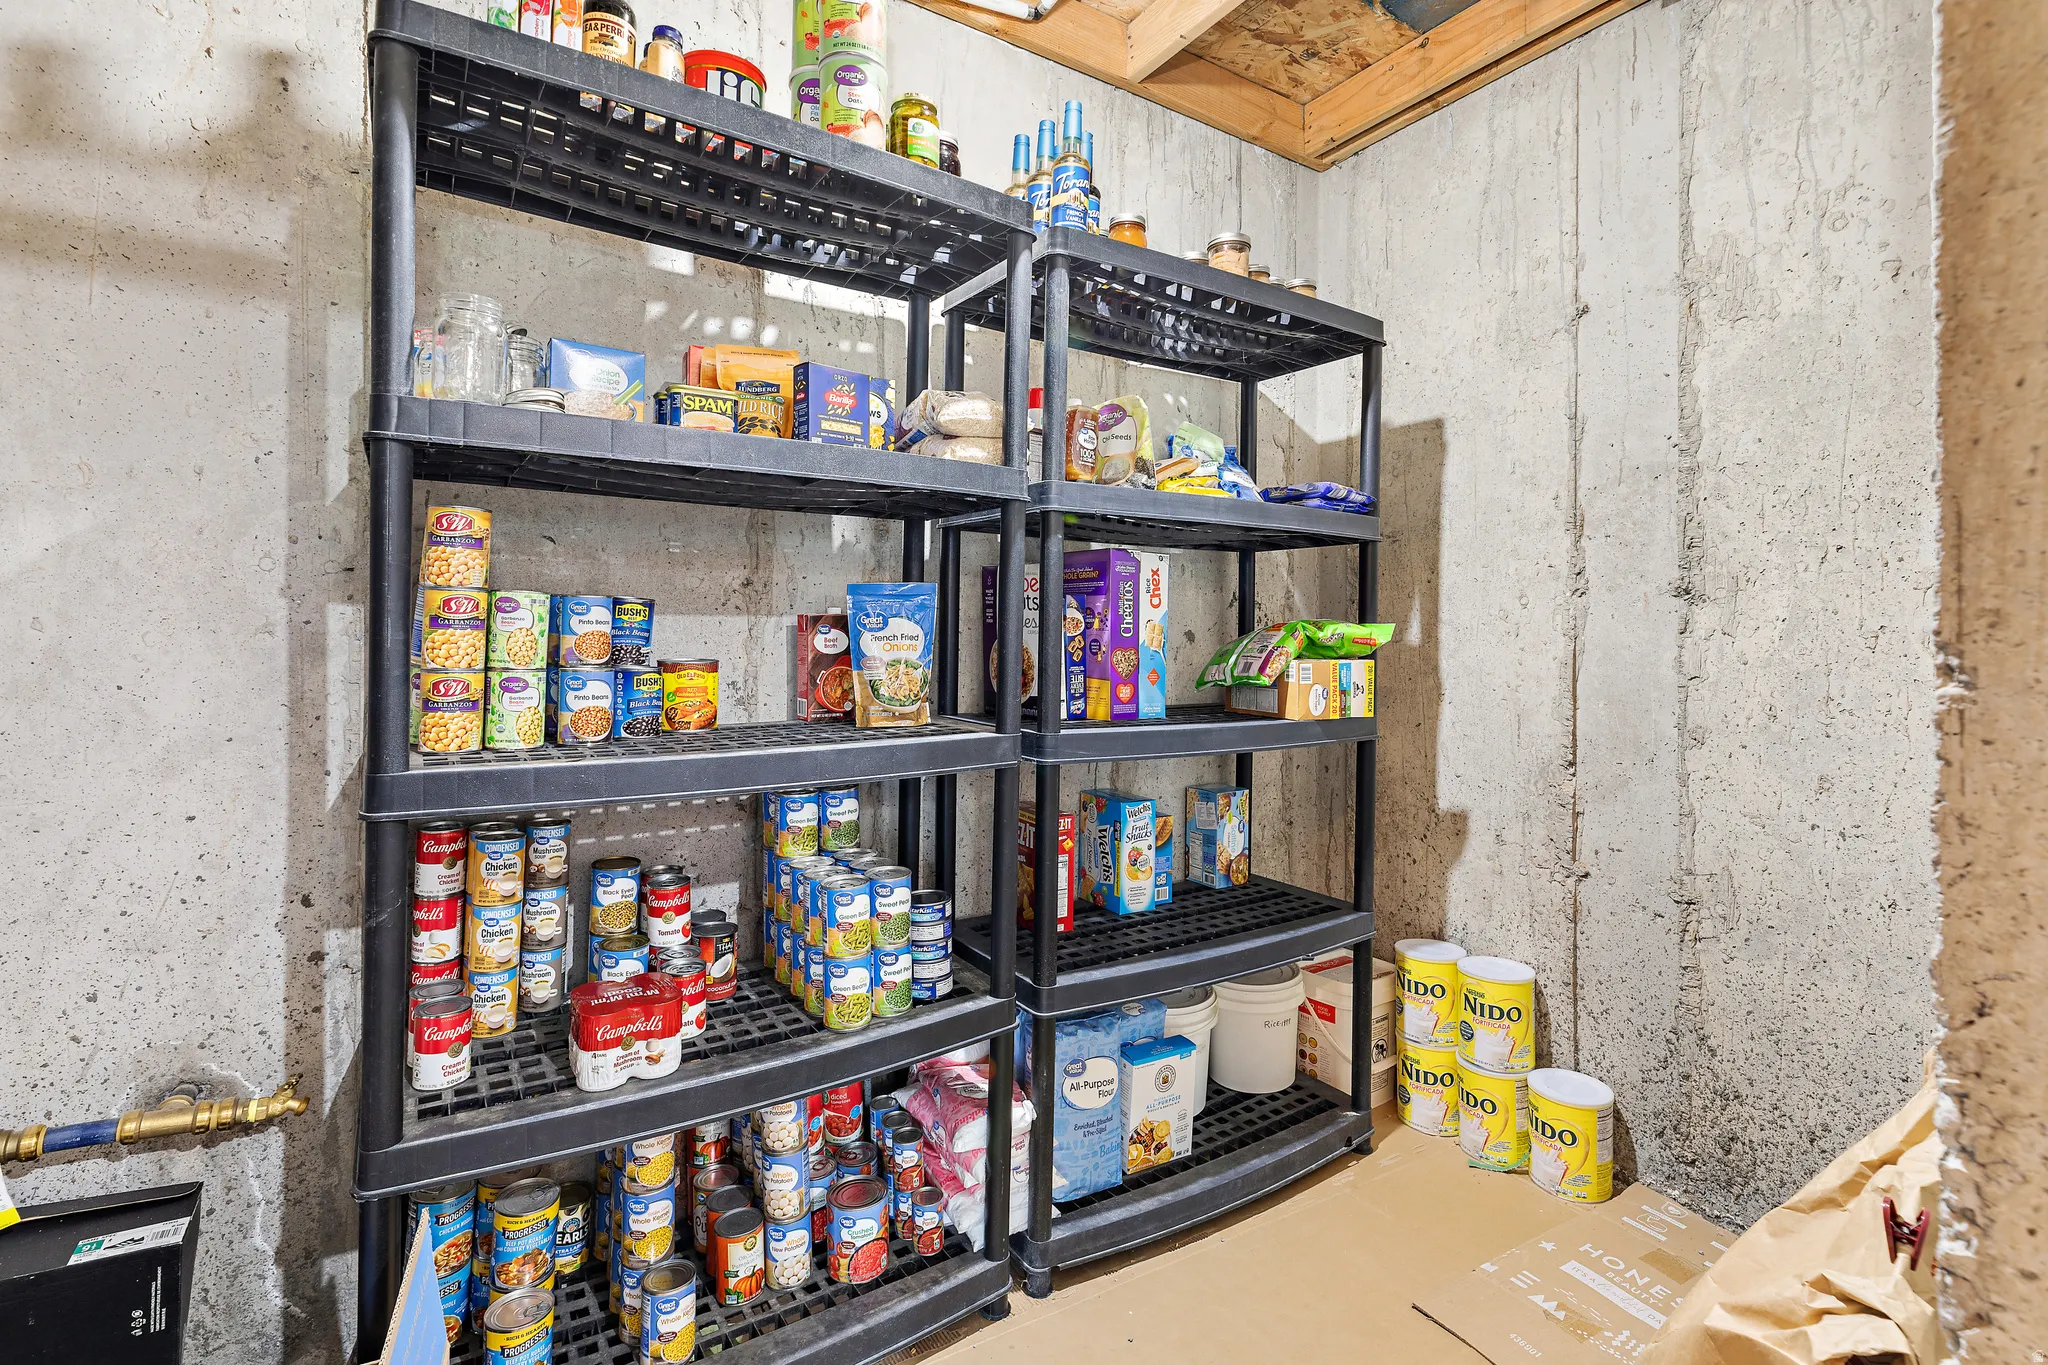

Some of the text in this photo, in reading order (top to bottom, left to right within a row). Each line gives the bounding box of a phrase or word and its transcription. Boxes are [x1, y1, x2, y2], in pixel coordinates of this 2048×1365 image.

[836, 70, 865, 80] Organic
[800, 86, 820, 99] Orga
[833, 374, 848, 382] ORZO
[738, 382, 778, 393] LUNDBERG
[682, 395, 732, 416] SPAM
[828, 394, 854, 406] Barilla
[760, 400, 784, 425] RICE
[1080, 448, 1096, 460] 100%
[432, 535, 476, 544] GARBANZOS
[1064, 572, 1078, 580] HOLE
[1149, 567, 1162, 610] Chex
[494, 600, 518, 610] Organic
[1120, 580, 1134, 638] Cheerios
[617, 606, 648, 618] BUSH'S
[437, 618, 482, 626] GARBANZOS
[860, 616, 884, 624] Great
[866, 620, 884, 629] Value
[824, 636, 838, 644] Beef
[870, 633, 920, 642] French Fried
[882, 642, 918, 652] Onions
[676, 672, 686, 680] OLD
[692, 672, 706, 680] PASO
[501, 681, 526, 690] Organic
[428, 700, 474, 709] GARBANZOS
[1126, 804, 1152, 820] Welch's
[532, 828, 565, 838] CONDENSED
[1131, 822, 1150, 836] Fruit
[1126, 830, 1152, 844] Snacks
[485, 842, 519, 852] CONDENSED
[532, 846, 564, 854] Mushroom
[1098, 828, 1112, 882] Welch's
[485, 862, 518, 872] Chicken
[439, 878, 460, 886] Chicken
[526, 890, 557, 900] CONDENSED
[620, 887, 634, 896] Eyed
[620, 892, 634, 900] Peas
[879, 900, 897, 908] Sweet
[481, 908, 516, 920] CONDENSED
[481, 928, 514, 938] Chicken
[658, 928, 680, 936] Tomato
[522, 952, 552, 962] CONDENSED
[626, 968, 640, 977] Eyed
[474, 973, 508, 984] CONDENSED
[1396, 972, 1446, 999] NIDO
[474, 993, 506, 1004] Chicken
[1402, 992, 1434, 1006] FORTIFICADA
[1464, 993, 1522, 1022] NIDO
[596, 1015, 663, 1042] Campbell's
[1472, 1016, 1512, 1030] FORTIFICADA
[613, 1056, 642, 1068] Mushroom
[616, 1052, 633, 1062] Cream
[441, 1062, 461, 1072] Cream
[620, 1063, 634, 1072] SOUP
[1066, 1061, 1082, 1070] Great
[443, 1066, 466, 1078] Chicken
[1400, 1060, 1455, 1088] NIDO
[446, 1076, 463, 1086] SOUP
[1070, 1078, 1115, 1092] All-Purpose
[1098, 1088, 1115, 1098] Flour
[1408, 1082, 1444, 1095] FORTIFICADA
[830, 1092, 848, 1100] diced
[1146, 1094, 1181, 1110] ALL-PURPOSE
[1096, 1114, 1114, 1127] Blended
[634, 1142, 655, 1150] Whole
[1530, 1130, 1563, 1152] FORTIFICADA
[772, 1171, 792, 1179] Whole
[524, 1214, 546, 1224] HEARTY
[438, 1224, 460, 1236] CHICKEN
[504, 1220, 548, 1239] PROGRESSO
[556, 1224, 589, 1245] EARLS
[847, 1226, 874, 1236] Crushed
[517, 1238, 528, 1246] POT
[529, 1234, 545, 1244] ROAST
[785, 1234, 805, 1247] Whole
[850, 1232, 874, 1240] Tomatoes
[782, 1240, 806, 1252] Potatoes
[1572, 1266, 1588, 1278] IT'S
[1579, 1243, 1684, 1309] HONES
[658, 1301, 676, 1310] Great
[660, 1314, 682, 1326] Whole
[526, 1322, 546, 1337] HEARTY
[504, 1329, 547, 1358] PROGRESSO
[1509, 1332, 1542, 1358] 436901
